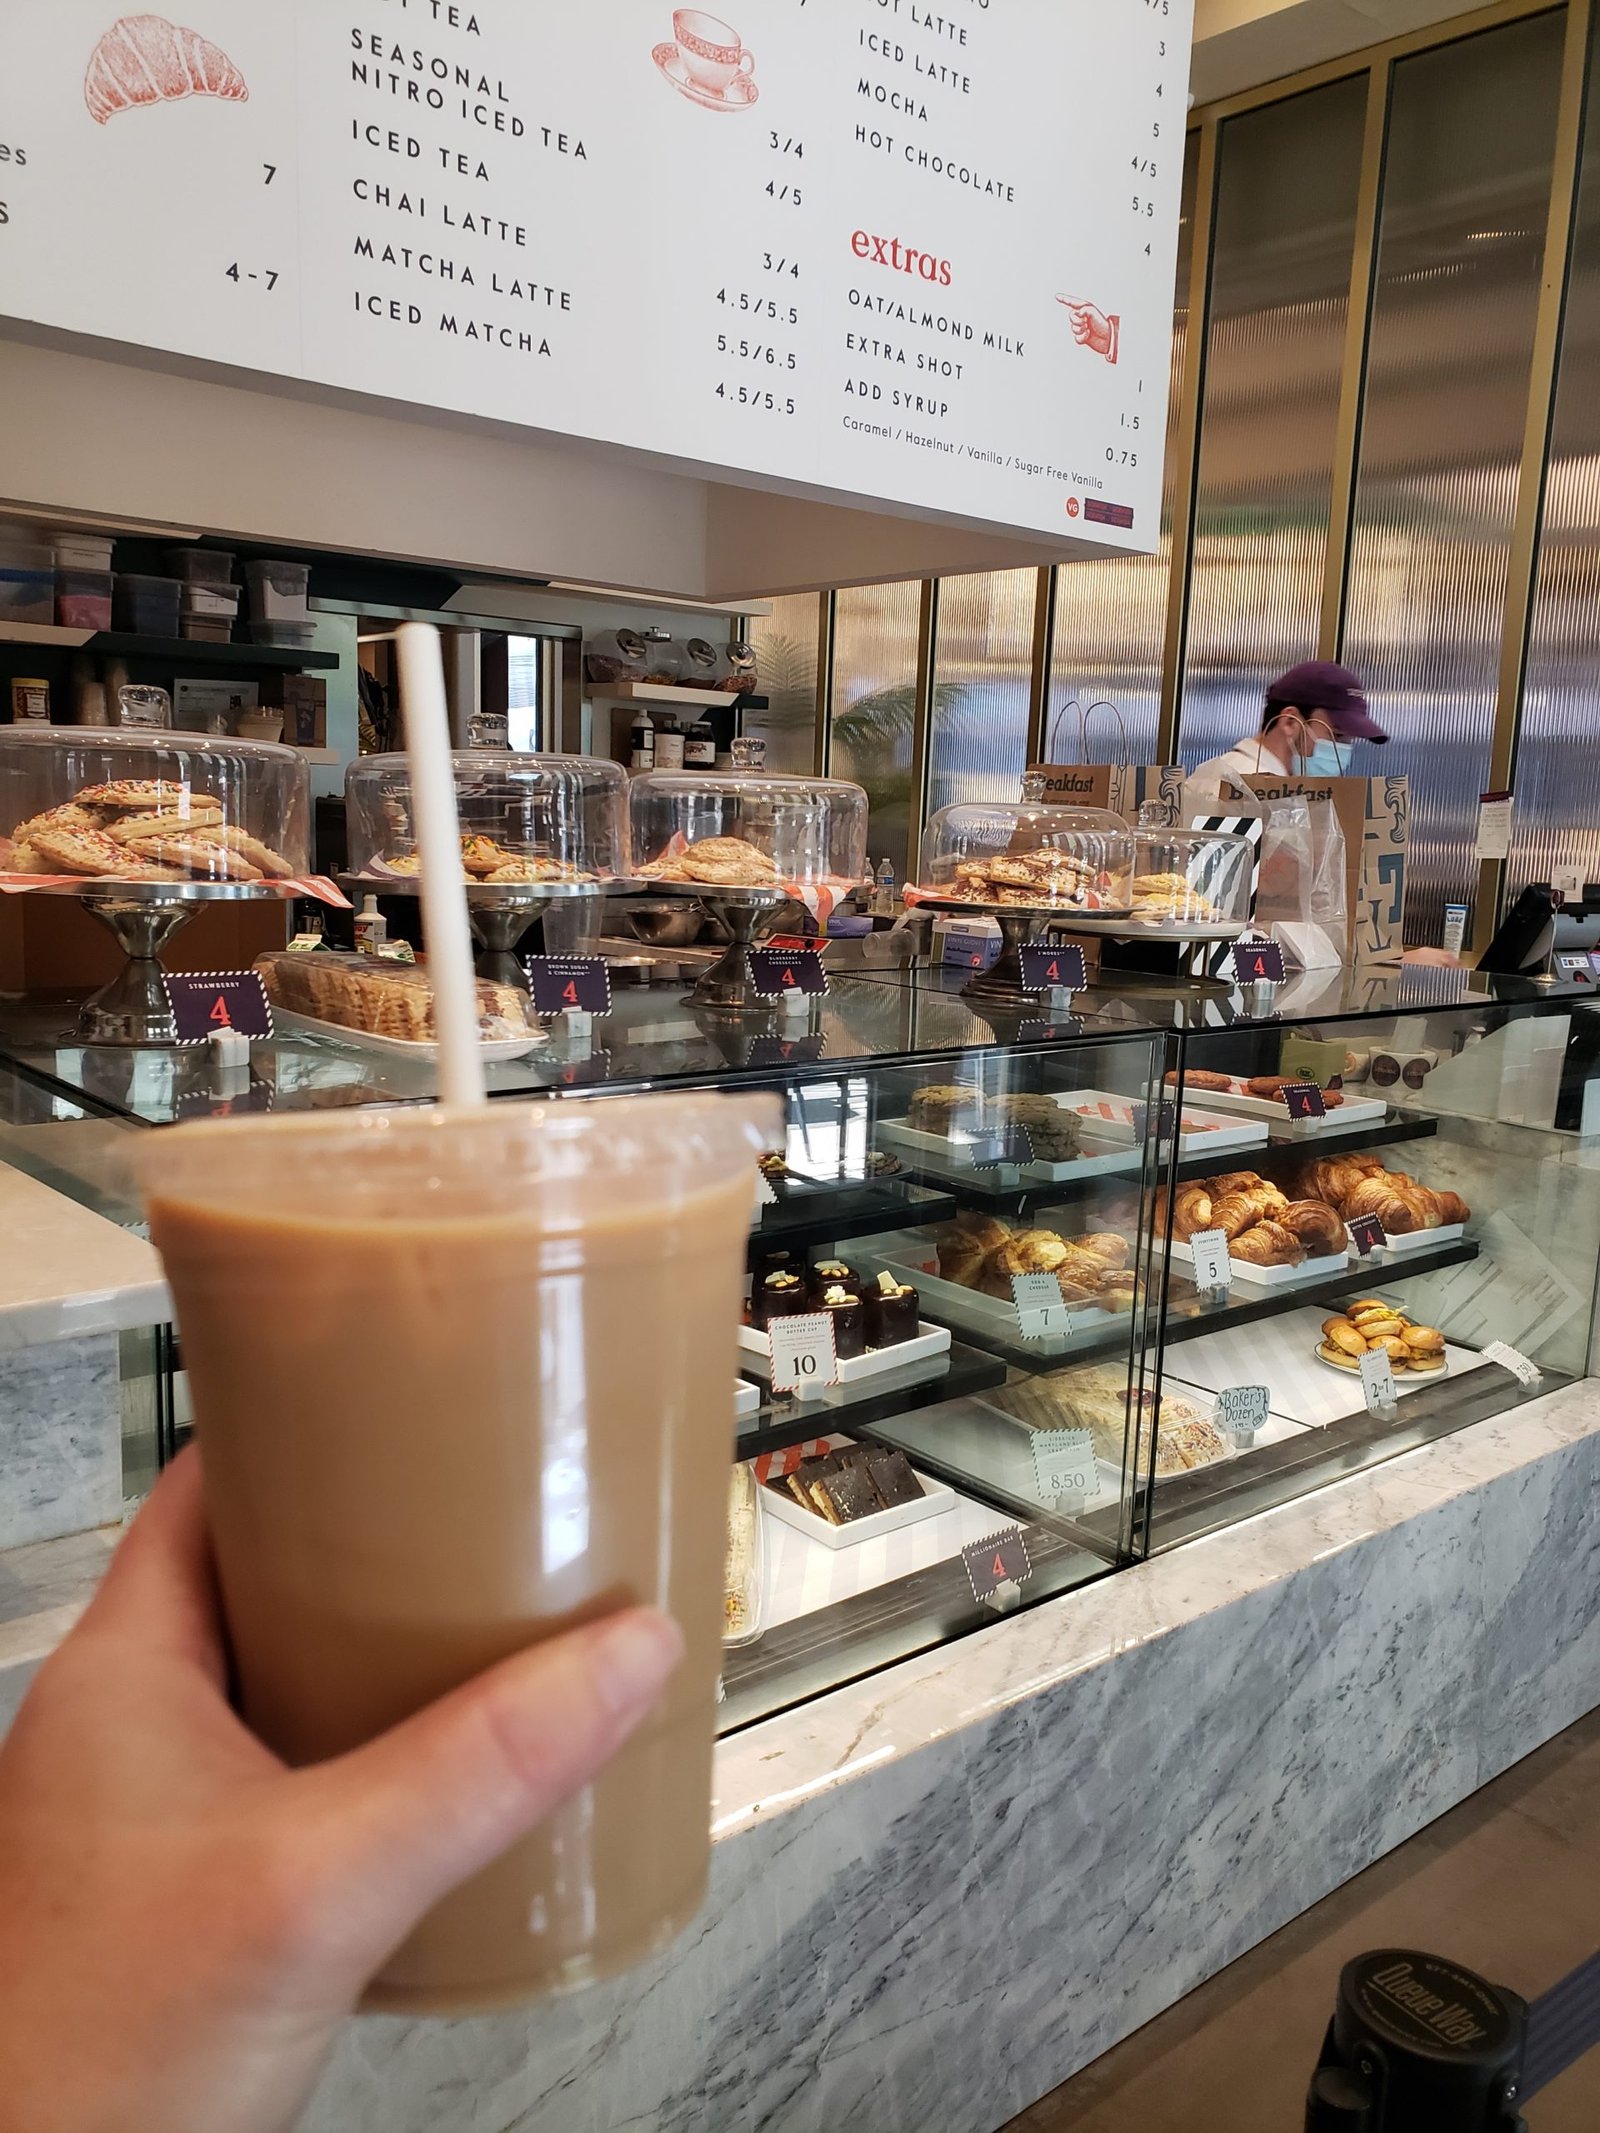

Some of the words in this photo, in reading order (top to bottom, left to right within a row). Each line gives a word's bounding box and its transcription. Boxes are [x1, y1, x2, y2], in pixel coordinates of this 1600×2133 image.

[429, 0, 480, 36] TEA
[911, 5, 968, 46] LATTE
[1158, 41, 1166, 56] 3
[352, 28, 510, 102] SEASONAL
[859, 29, 905, 62] ICED
[915, 54, 971, 93] LATTE
[858, 78, 928, 122] MOCHA
[1155, 84, 1163, 98] 4
[352, 60, 444, 110] NITRO
[462, 98, 525, 137] ICED
[540, 127, 588, 161] TEA
[1152, 123, 1160, 138] 5
[352, 119, 421, 159] ICED
[438, 148, 490, 182] TEA
[769, 131, 804, 160] 3/4
[263, 164, 277, 185] 7
[855, 124, 893, 154] HOT
[904, 146, 1015, 203] CHOCOLATE
[1131, 156, 1157, 177] 4/5
[765, 181, 802, 206] 4/5
[352, 179, 425, 218] CHAI
[443, 205, 526, 247] LATTE
[1131, 197, 1154, 217] 5.5
[851, 230, 952, 287] extras
[1144, 243, 1151, 257] 4
[354, 236, 475, 287] MATCHA
[492, 272, 571, 312] LATTE
[763, 253, 799, 279] 3/4
[716, 287, 798, 325] 4.5/5.5
[354, 291, 422, 325] ICED
[439, 314, 552, 357] MATCHA
[848, 289, 974, 341] OAT/ALMOND
[983, 332, 1025, 358] MILK
[717, 334, 796, 370] 5.5/6.5
[846, 333, 906, 365] EXTRA
[916, 354, 964, 380] SHOT
[715, 381, 795, 415] 4.5/5.5
[844, 378, 882, 401] ADD
[892, 390, 949, 419] SYRUP
[1120, 413, 1140, 430] 1.5
[842, 415, 892, 438] Caramel
[905, 431, 954, 454] Hazelnut
[967, 446, 1003, 466] Vanilla
[1014, 458, 1043, 476] Sugar
[1046, 466, 1068, 481] Free
[1071, 472, 1103, 490] Vanilla
[1105, 447, 1138, 467] 0.75
[1068, 502, 1078, 513] VG
[782, 968, 796, 986] 4
[1046, 960, 1060, 981] 4
[1254, 956, 1266, 975] 4
[562, 980, 578, 1002] 4
[210, 996, 232, 1025] 4
[1301, 1096, 1312, 1112] 4
[1367, 1230, 1376, 1245] 4
[1208, 1262, 1217, 1278] 5
[775, 1322, 806, 1331] CHOCOLATE
[1040, 1308, 1049, 1326] 7
[793, 1354, 816, 1376] 10
[1370, 1382, 1379, 1398] 2
[1383, 1377, 1388, 1393] 7
[1224, 1391, 1262, 1410] Baker's
[1225, 1406, 1255, 1422] Dozen
[1050, 1472, 1085, 1489] 8.50
[971, 1539, 1003, 1557] MILLIONAIRE
[1003, 1535, 1013, 1543] BAR
[992, 1552, 1007, 1577] 4
[1372, 1962, 1444, 2016] Queue
[1427, 2002, 1487, 2045] Way
